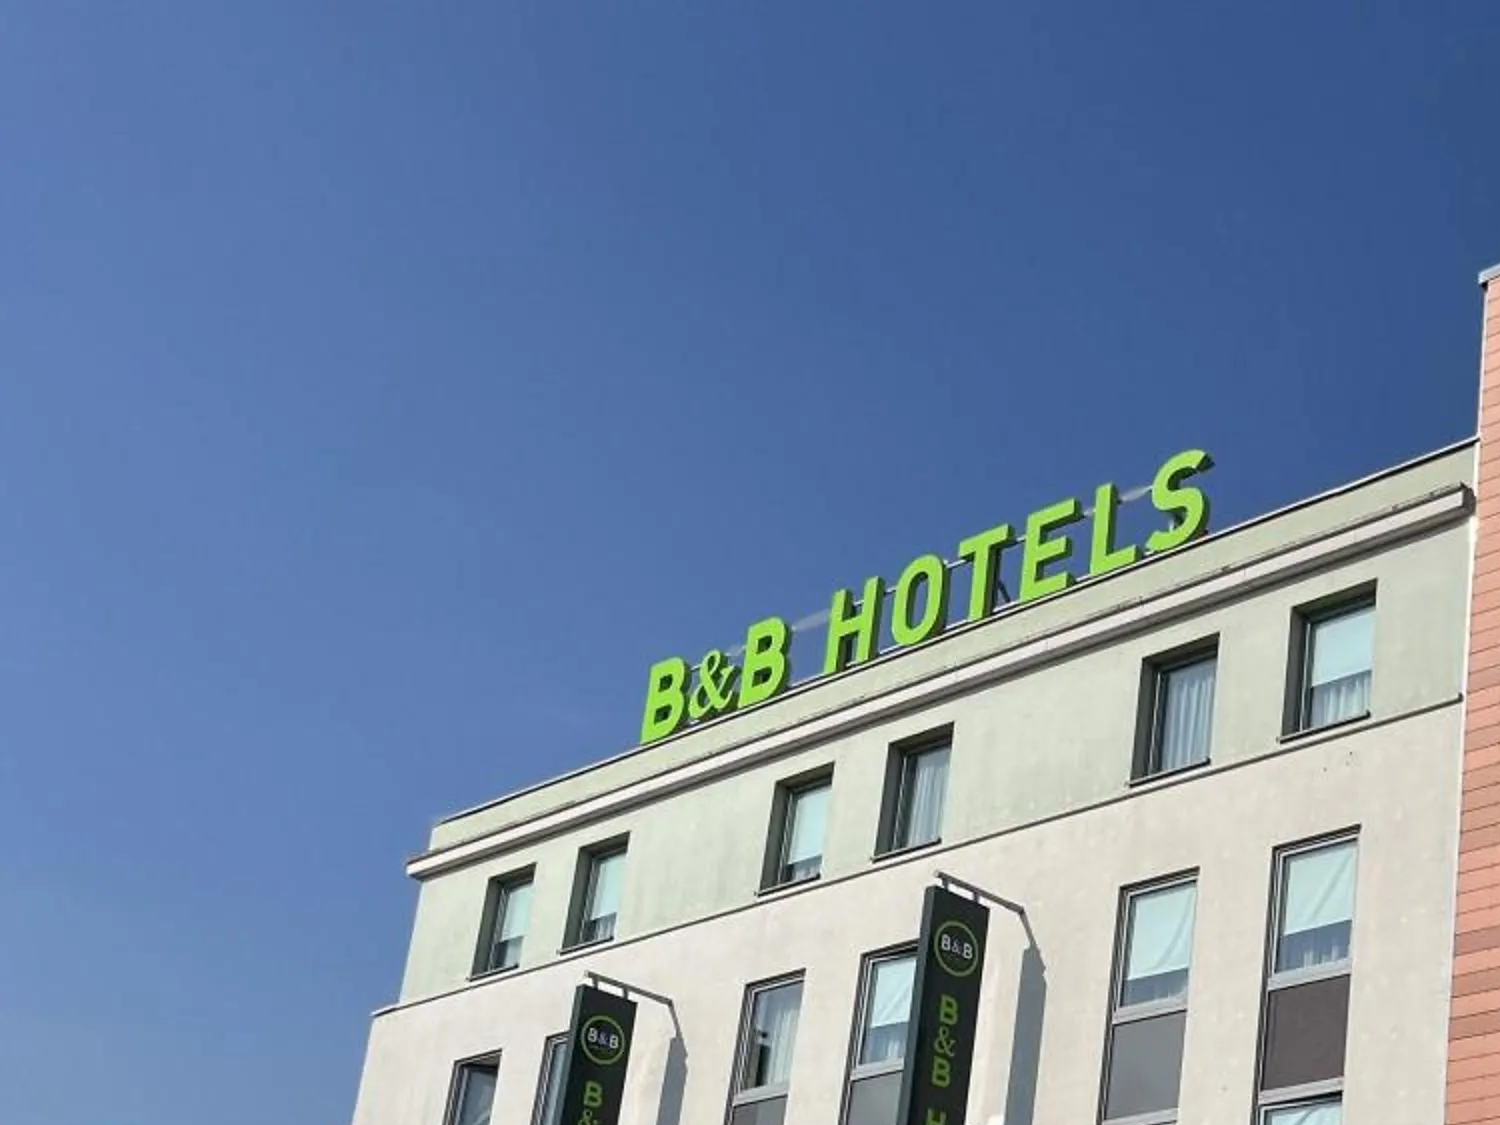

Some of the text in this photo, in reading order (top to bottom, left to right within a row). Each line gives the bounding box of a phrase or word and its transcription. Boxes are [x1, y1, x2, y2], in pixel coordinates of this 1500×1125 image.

[640, 449, 1214, 744] B&B HOTELS
[941, 934, 973, 959] B&B
[587, 1027, 619, 1049] B&B
[931, 995, 958, 1088] B&B
